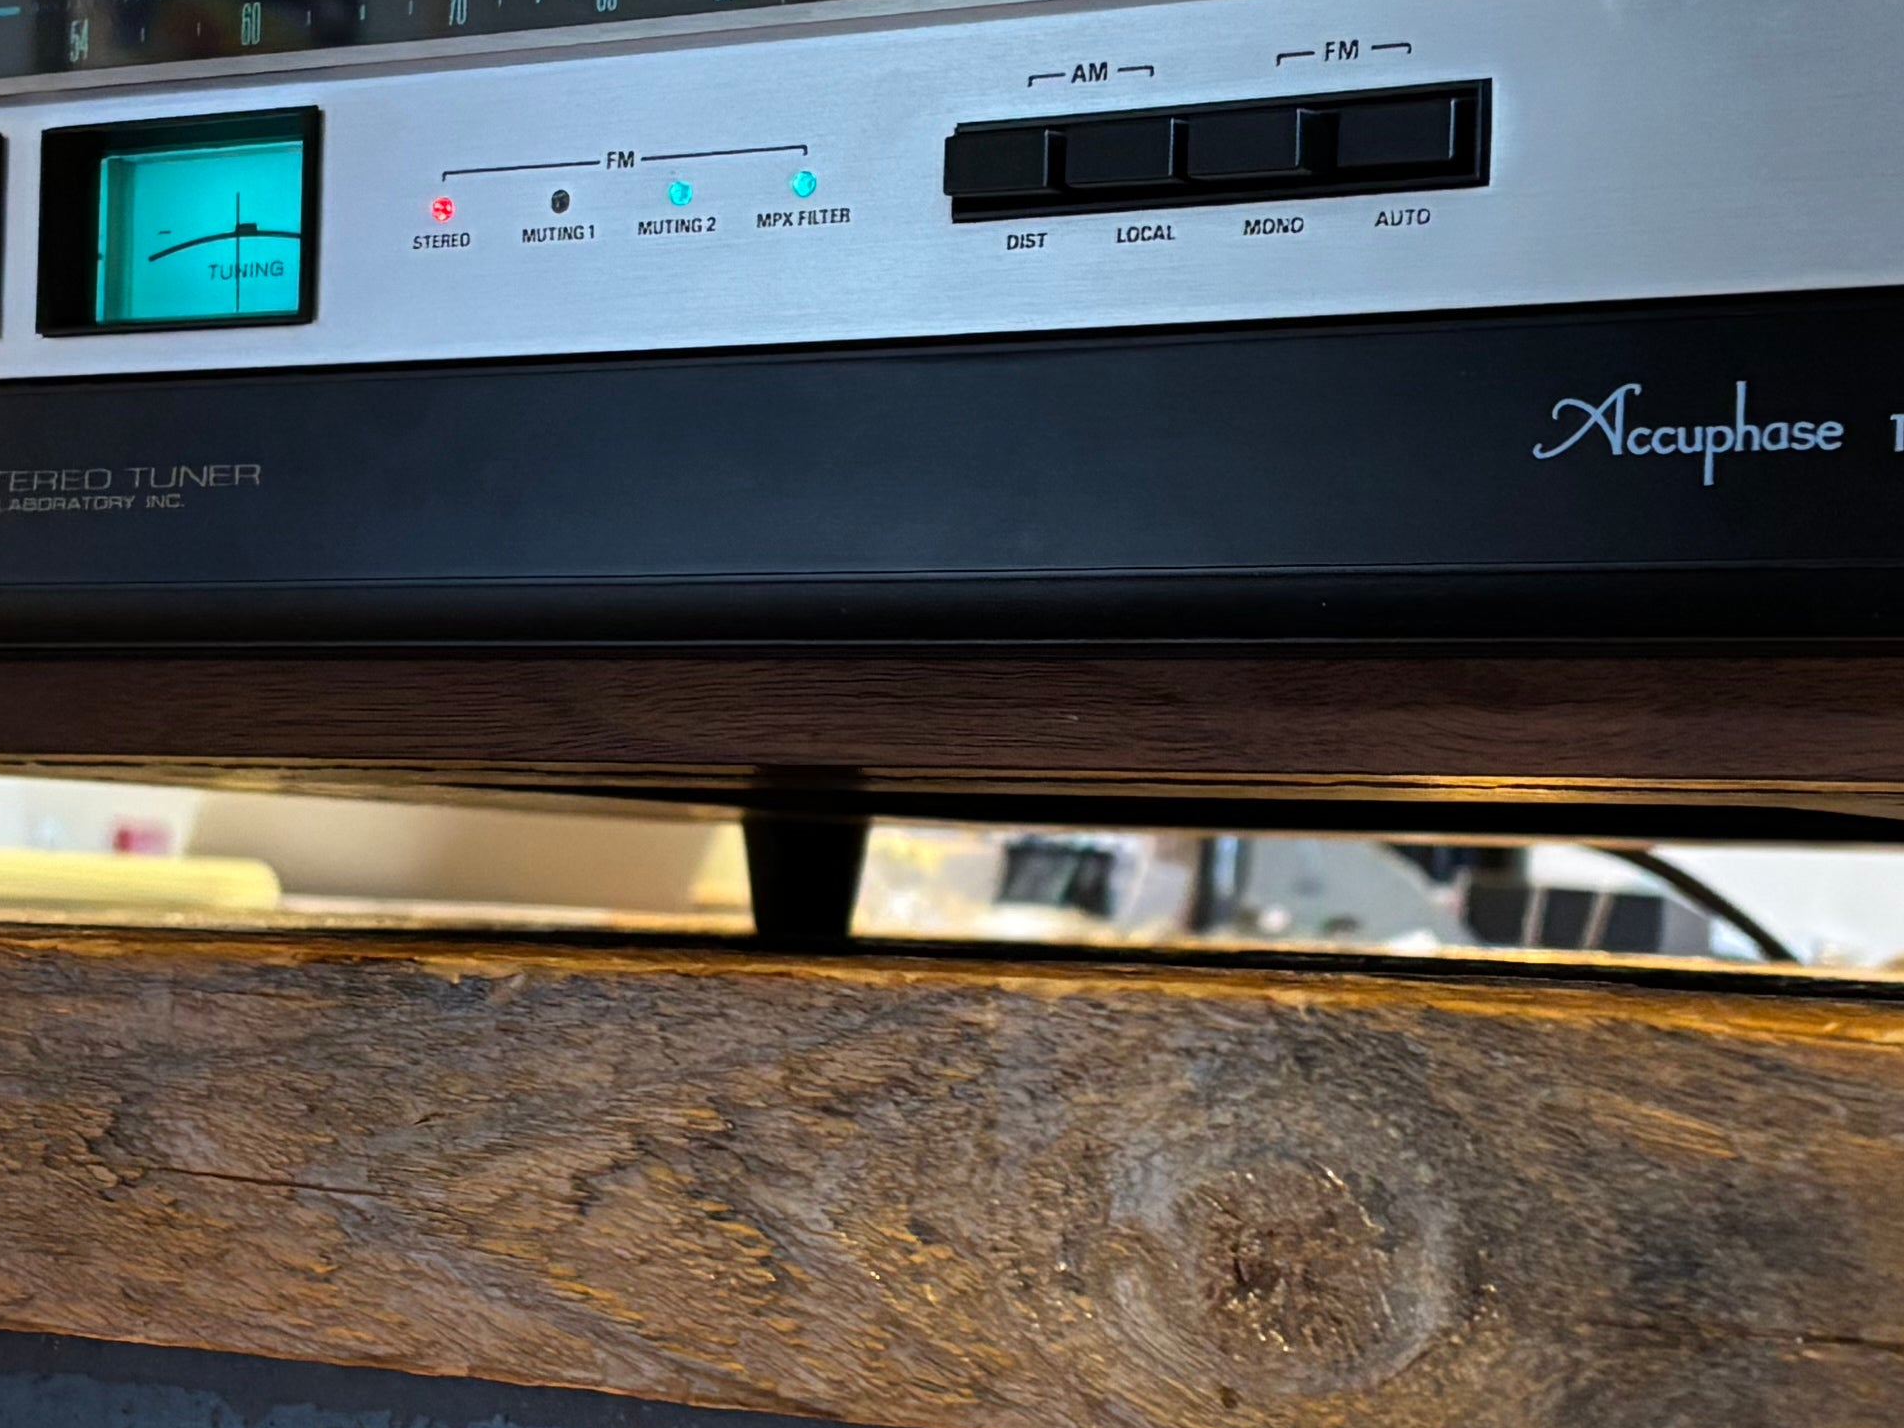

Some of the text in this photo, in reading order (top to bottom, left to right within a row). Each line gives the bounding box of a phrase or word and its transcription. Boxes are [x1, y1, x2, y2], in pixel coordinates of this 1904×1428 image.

[241, 2, 262, 47] 60
[1323, 39, 1361, 62] FM
[1070, 62, 1109, 85] AM
[606, 150, 636, 170] FM
[637, 216, 718, 236] MUTING 2
[756, 207, 852, 229] MPX FILTER
[1242, 216, 1305, 236] MONO
[1374, 207, 1432, 228] AUTO
[412, 231, 471, 251] STEREO
[521, 225, 596, 244] MUTING 1
[1006, 232, 1049, 251] DIST
[1116, 224, 1177, 244] LOCAL
[207, 260, 285, 281] TUNING
[1532, 380, 1845, 487] Accuphase
[124, 464, 263, 490] TUNER
